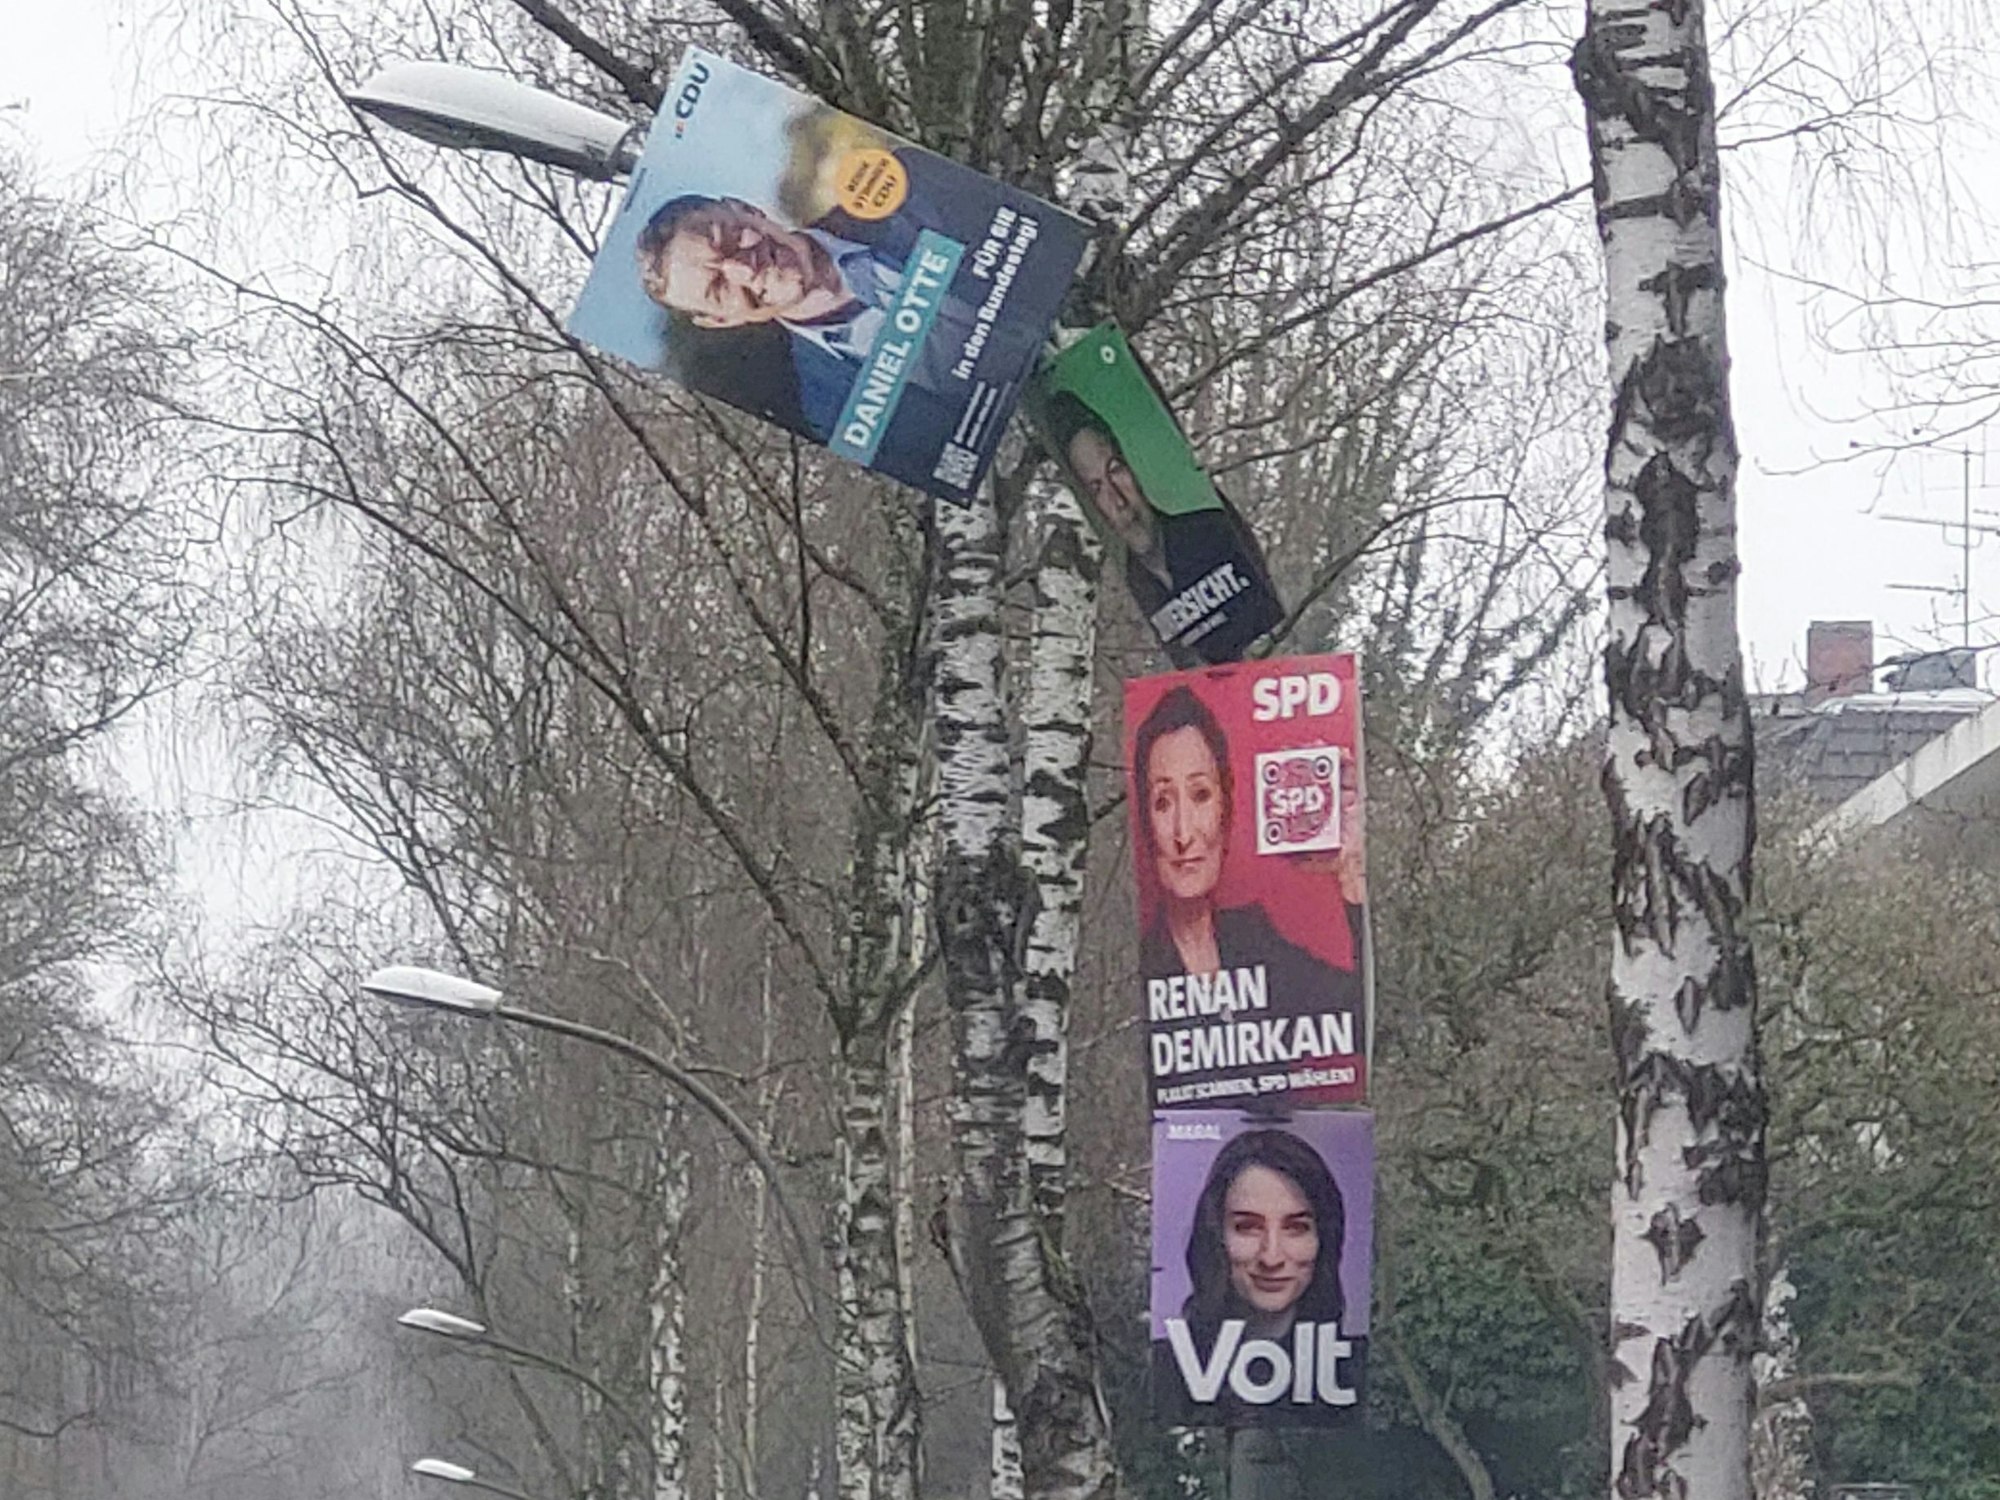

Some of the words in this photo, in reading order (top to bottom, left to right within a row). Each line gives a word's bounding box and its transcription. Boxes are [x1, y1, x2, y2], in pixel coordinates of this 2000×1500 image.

[676, 62, 709, 118] CDU
[973, 239, 1001, 280] FÜR
[844, 340, 912, 448] DANIEL
[895, 248, 949, 334] OTTE
[963, 322, 991, 358] den
[1253, 672, 1341, 721] SPD
[1270, 783, 1325, 816] SPD
[1148, 965, 1268, 1021] RENAN
[1151, 1012, 1354, 1076] DEMIRKAN
[1258, 1074, 1287, 1091] SPD
[1164, 1317, 1357, 1406] Volt
